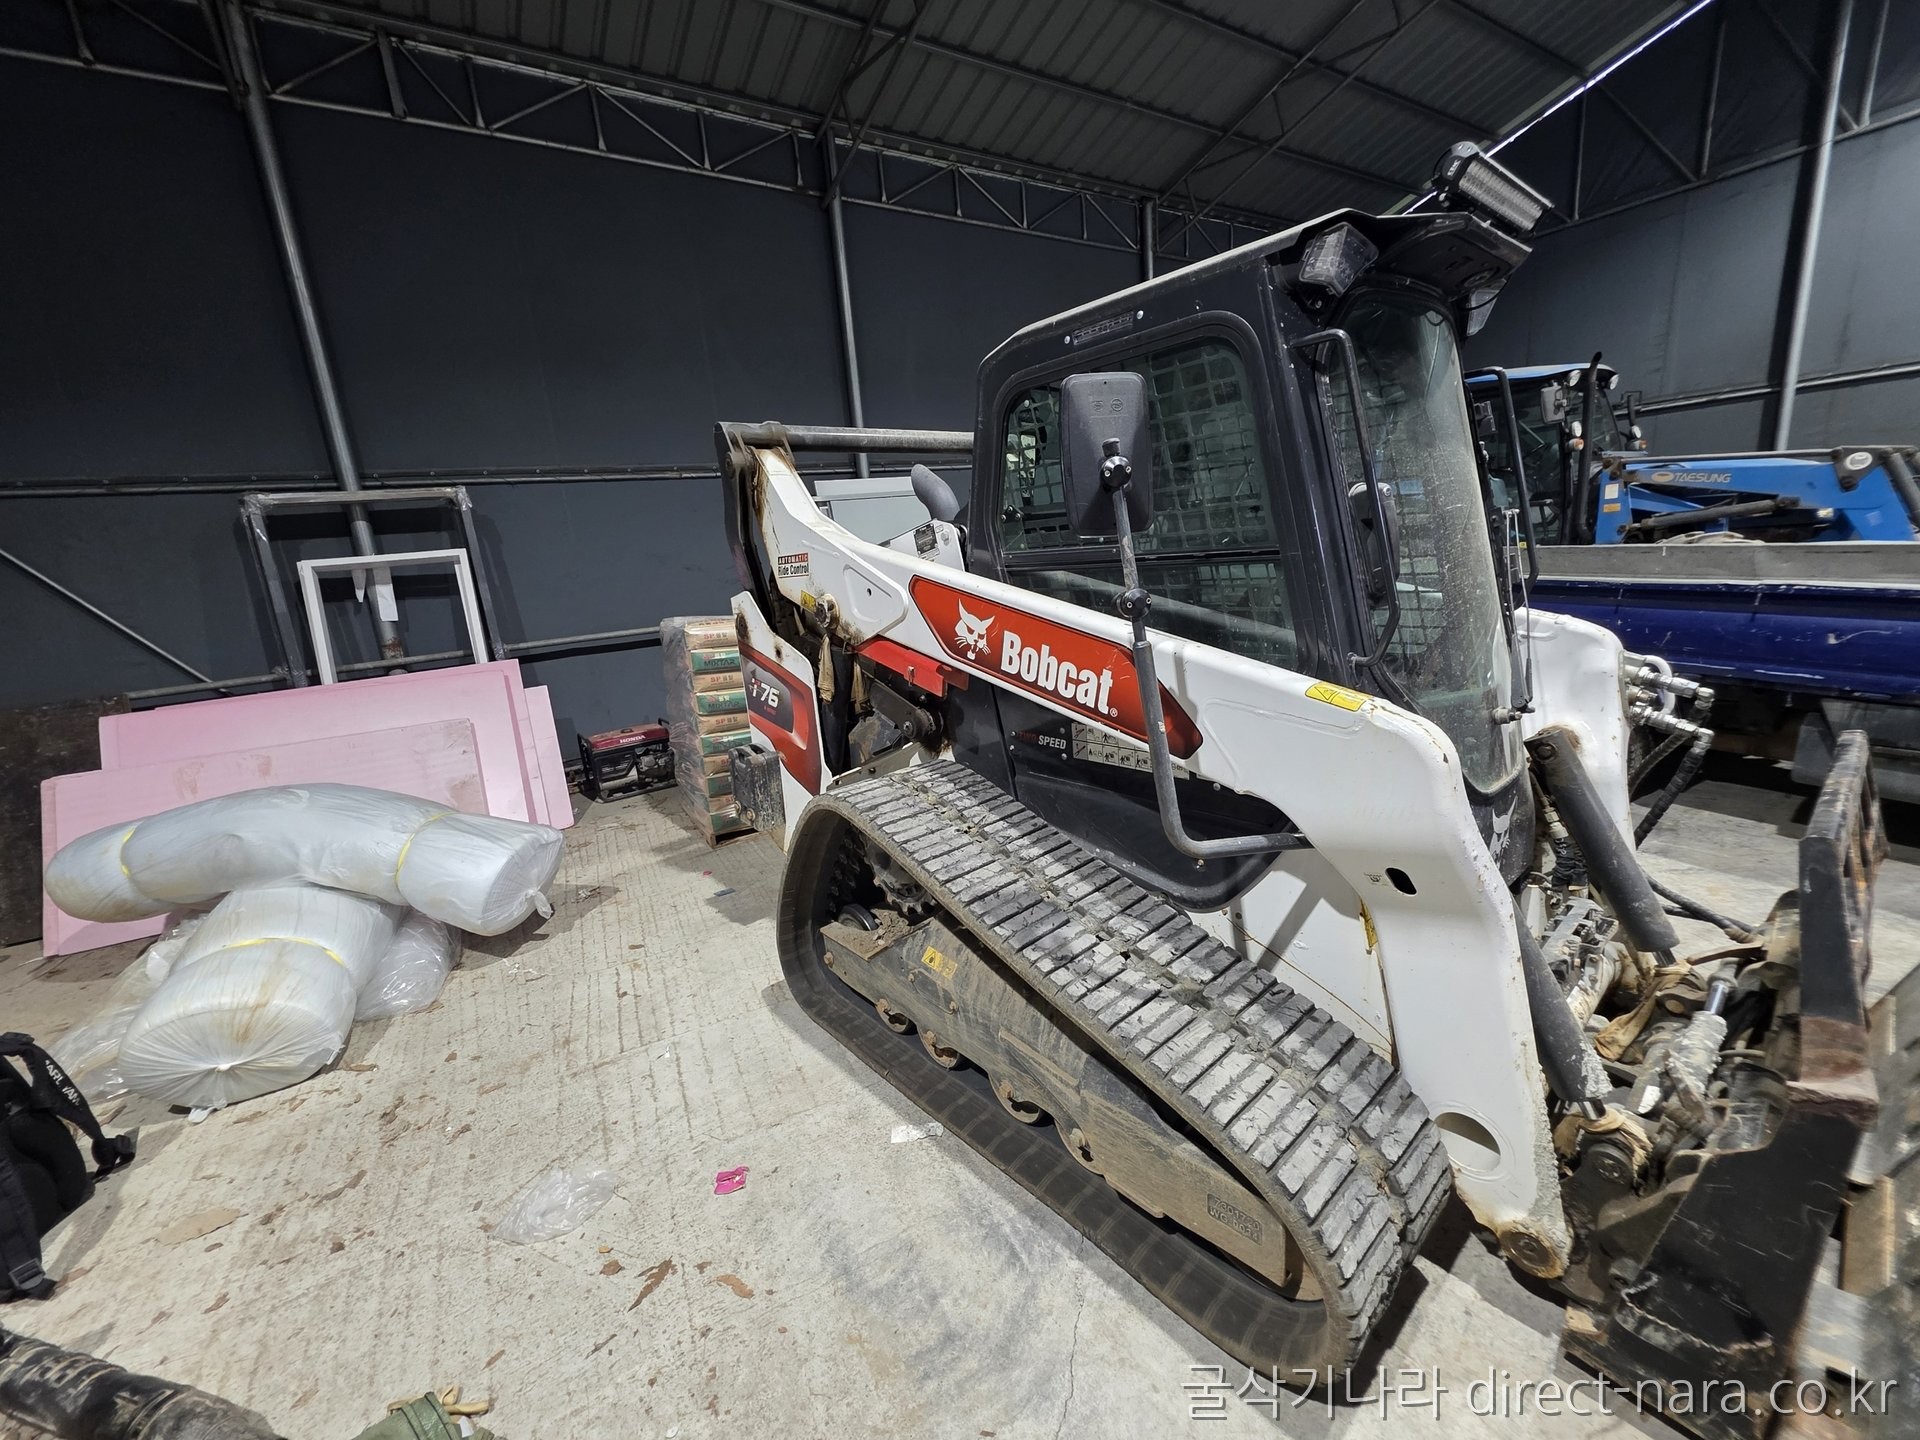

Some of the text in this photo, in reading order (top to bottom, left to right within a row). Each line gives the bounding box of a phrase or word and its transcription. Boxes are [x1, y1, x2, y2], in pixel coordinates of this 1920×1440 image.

[1674, 472, 1732, 483] TAESUNG
[778, 554, 808, 564] AUTOMATIC
[778, 563, 809, 576] Ride Control
[1000, 630, 1113, 715] Bobcat
[619, 734, 646, 744] HONDA
[1038, 734, 1067, 750] SPEED
